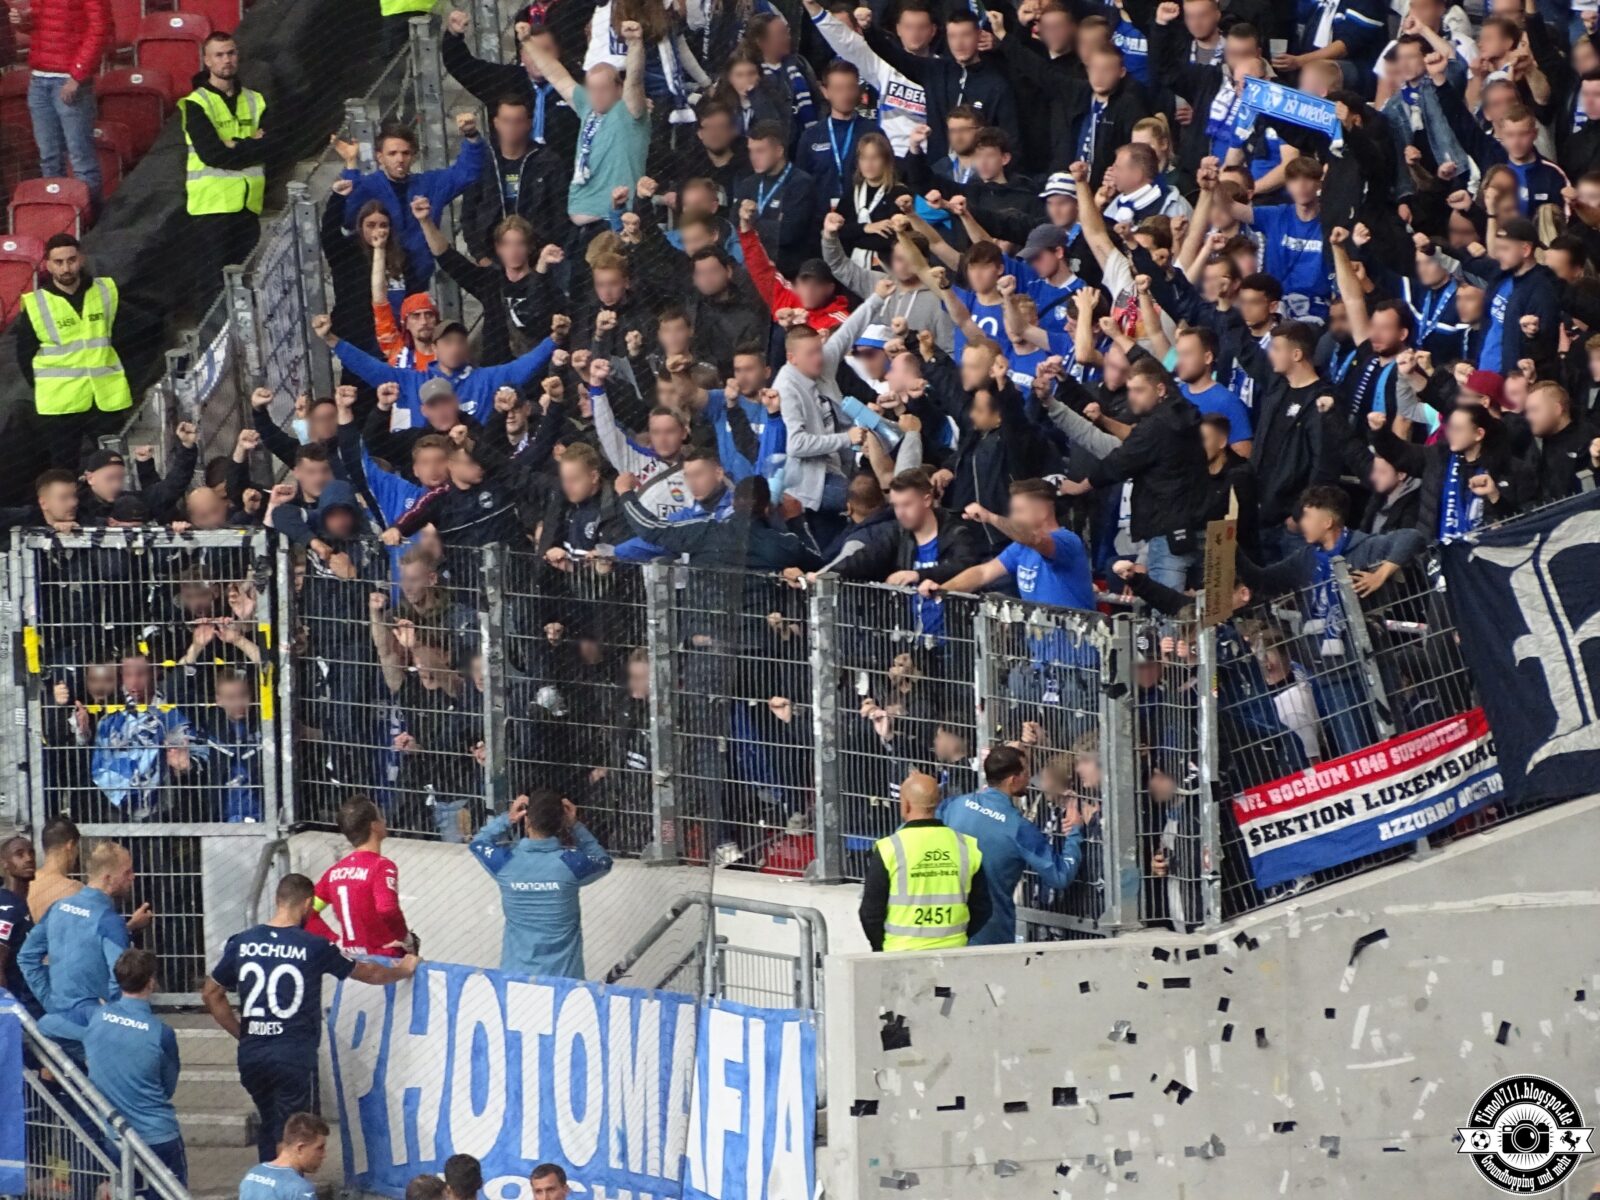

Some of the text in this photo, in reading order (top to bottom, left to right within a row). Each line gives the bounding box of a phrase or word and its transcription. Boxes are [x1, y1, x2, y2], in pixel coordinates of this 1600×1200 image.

[1268, 764, 1350, 805] BOCHUM
[1390, 718, 1468, 765] SUPPORTERS
[1248, 798, 1356, 847] SEKTION
[1378, 797, 1456, 841] AZZURRO
[924, 850, 950, 861] SDS
[337, 885, 356, 941] 1
[914, 907, 952, 925] 2451
[239, 942, 307, 961] BOCHUM
[239, 962, 305, 1019] 20
[334, 967, 811, 1200] PHOTOMAFIA
